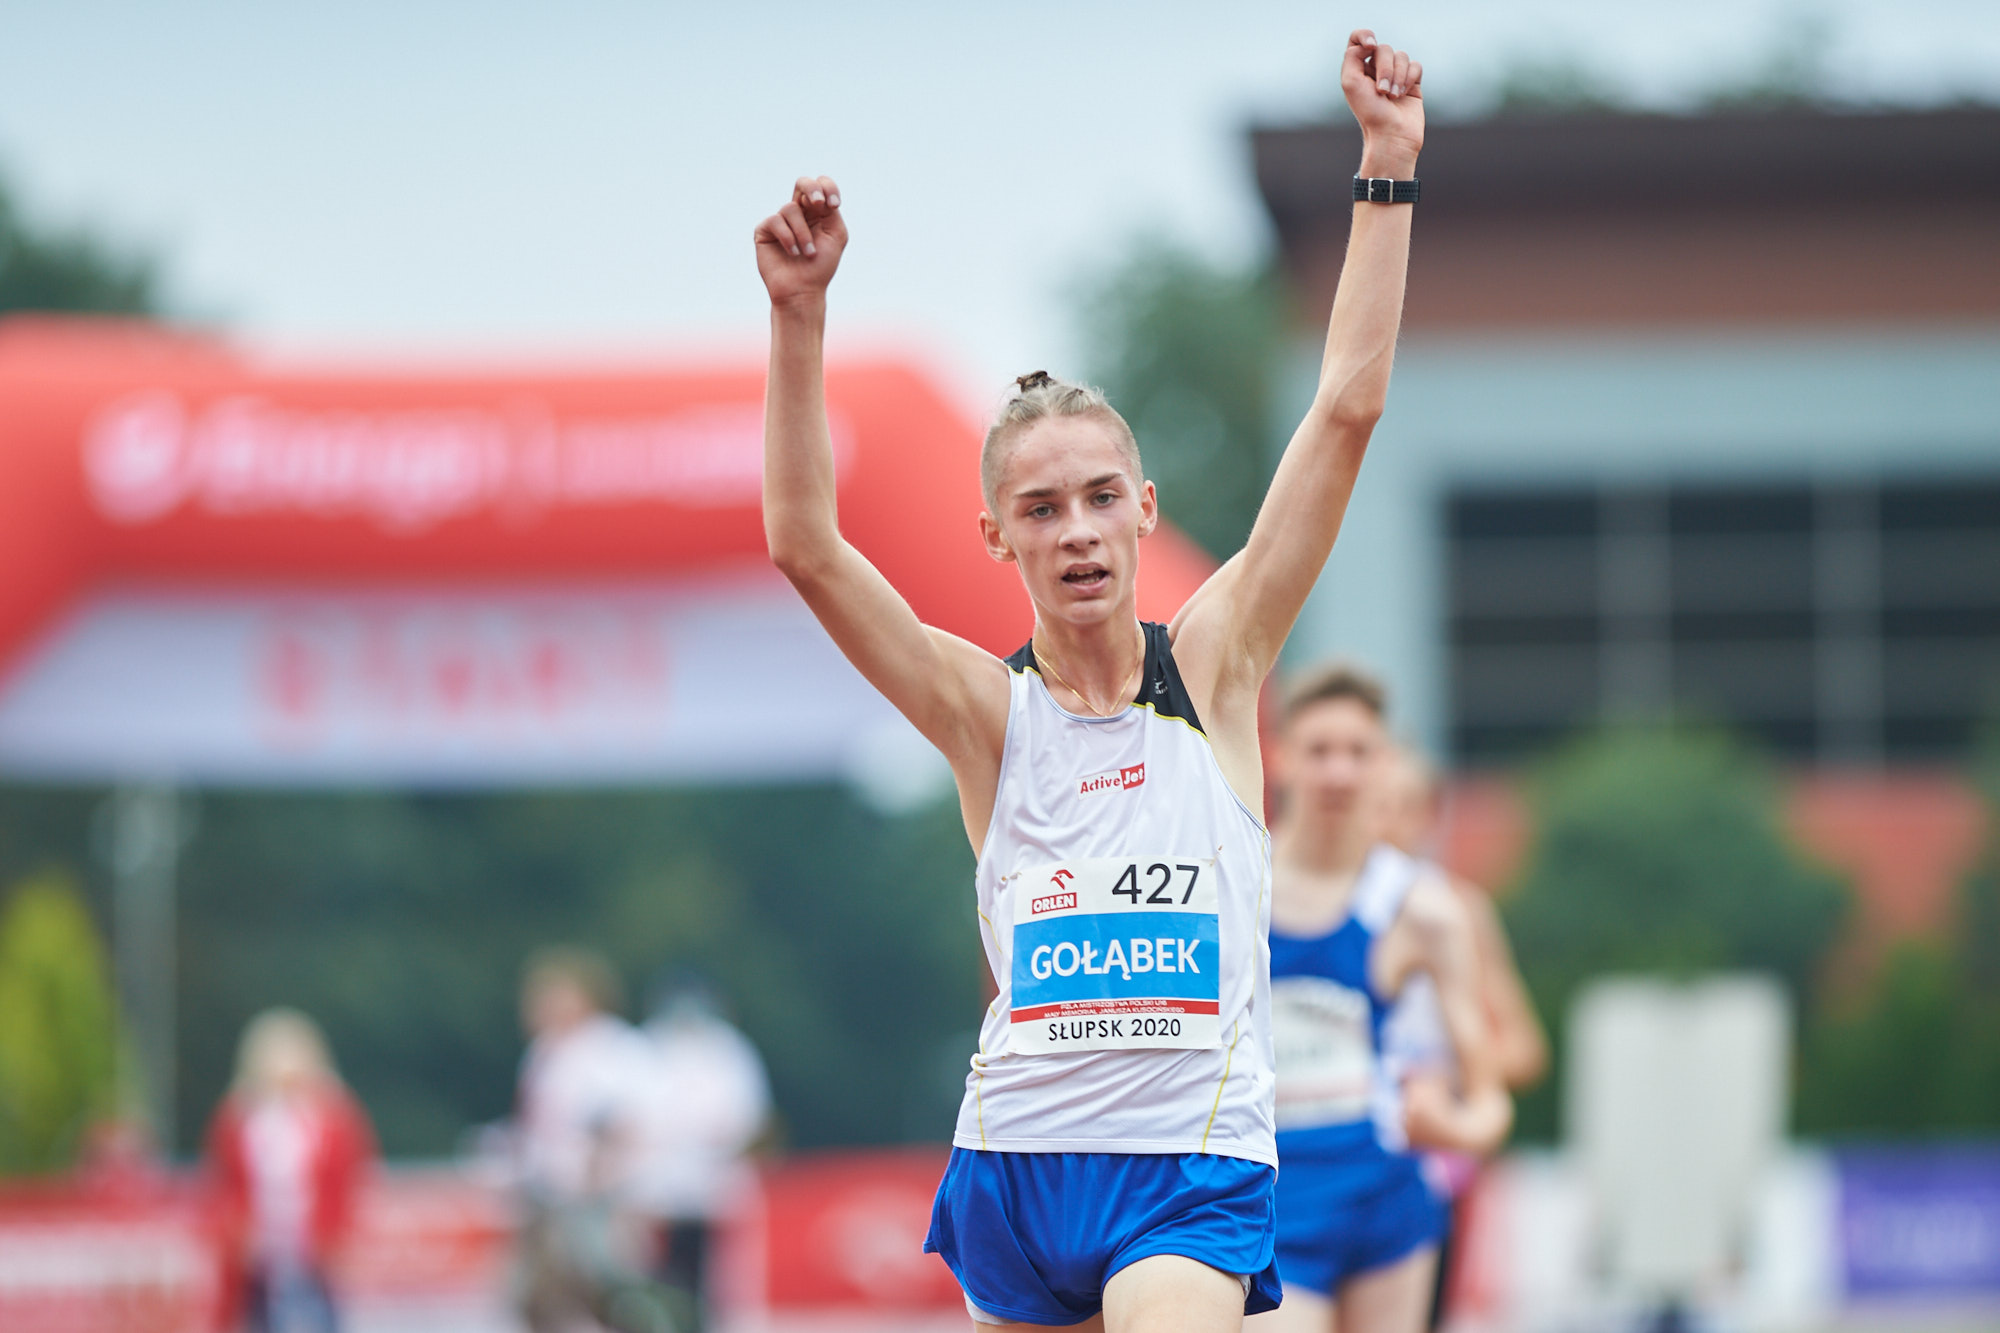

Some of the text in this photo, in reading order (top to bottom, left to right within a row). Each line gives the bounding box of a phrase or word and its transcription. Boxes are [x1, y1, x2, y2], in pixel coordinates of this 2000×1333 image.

[1112, 863, 1200, 905] 427
[1033, 894, 1075, 913] ORLEN
[1031, 938, 1201, 981] GOŁĄBEK
[1048, 1018, 1181, 1041] SŁUPSK 2020
